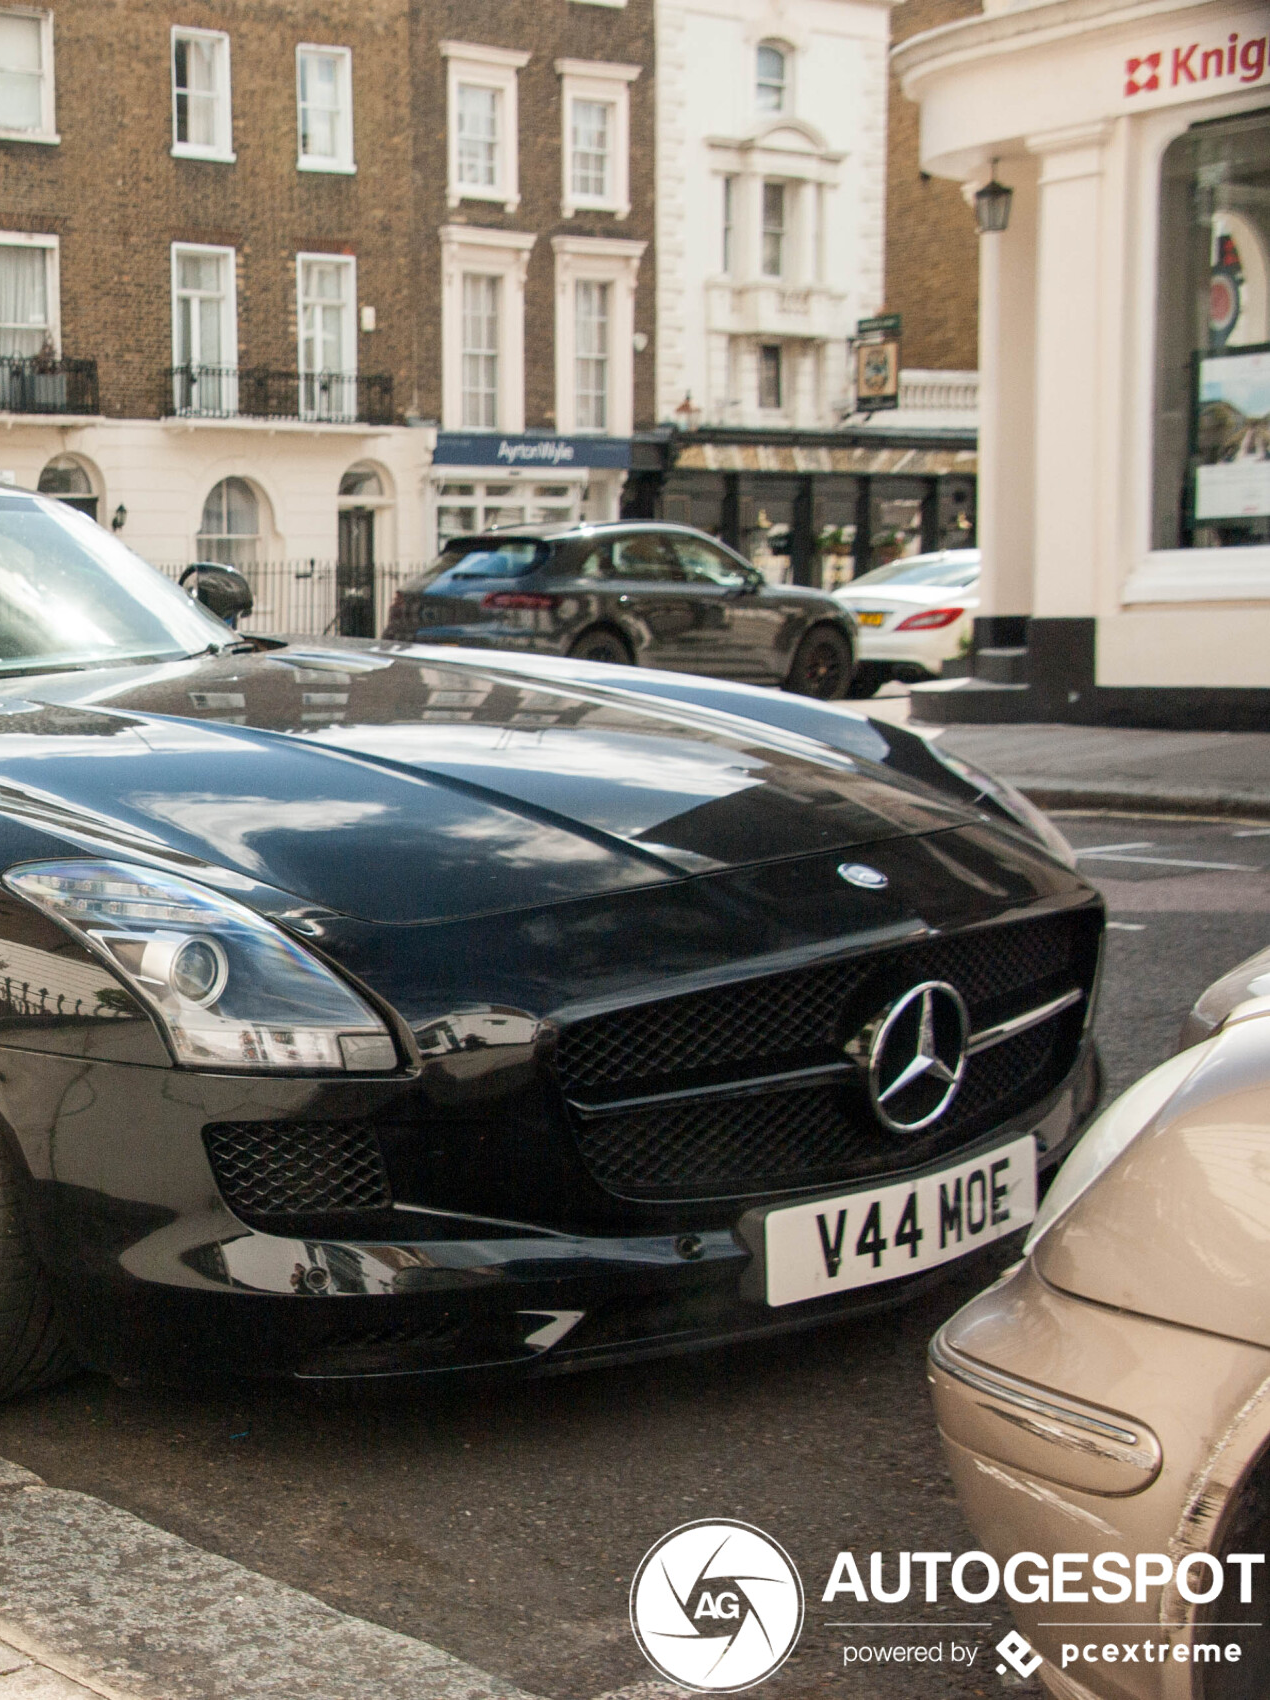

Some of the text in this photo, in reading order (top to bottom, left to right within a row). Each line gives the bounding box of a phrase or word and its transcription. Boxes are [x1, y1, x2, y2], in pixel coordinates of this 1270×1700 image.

[1172, 33, 1270, 87] Knig
[816, 1157, 1010, 1278] V44 MOE
